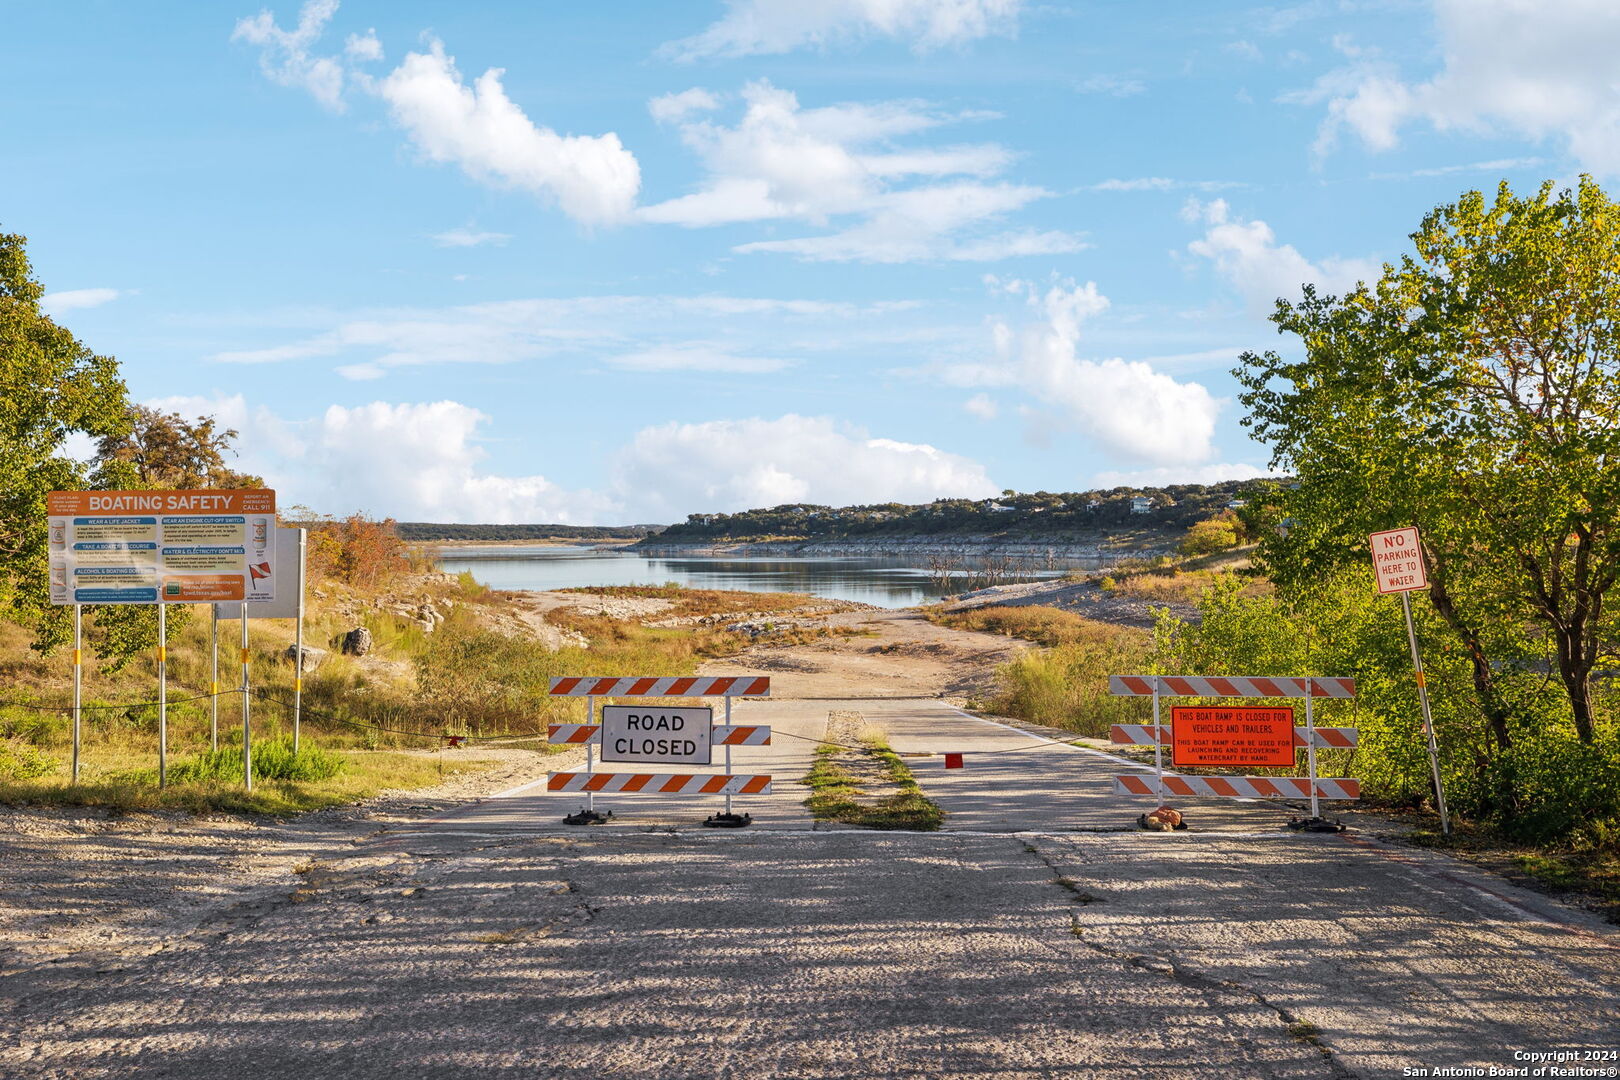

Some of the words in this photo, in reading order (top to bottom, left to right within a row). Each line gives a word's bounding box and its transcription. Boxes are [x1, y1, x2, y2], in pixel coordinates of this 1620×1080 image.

[89, 496, 162, 510] BOATING
[167, 495, 233, 509] SAFETY
[1384, 535, 1404, 548] NO
[1378, 549, 1416, 562] PARKING
[1382, 564, 1403, 574] HERE
[1407, 562, 1416, 570] TO
[1389, 575, 1415, 586] WATER
[628, 715, 684, 731] ROAD
[1179, 712, 1193, 720] THIS
[1196, 712, 1212, 720] BOAT
[1216, 712, 1232, 721] RAMP
[1236, 712, 1243, 721] IS
[1246, 713, 1270, 721] CLOSED
[1274, 713, 1287, 722] FOR
[1193, 725, 1223, 733] VEHICLES
[1227, 725, 1238, 733] AND
[1242, 725, 1273, 734] TRAILERS.
[615, 739, 696, 755] CLOSED
